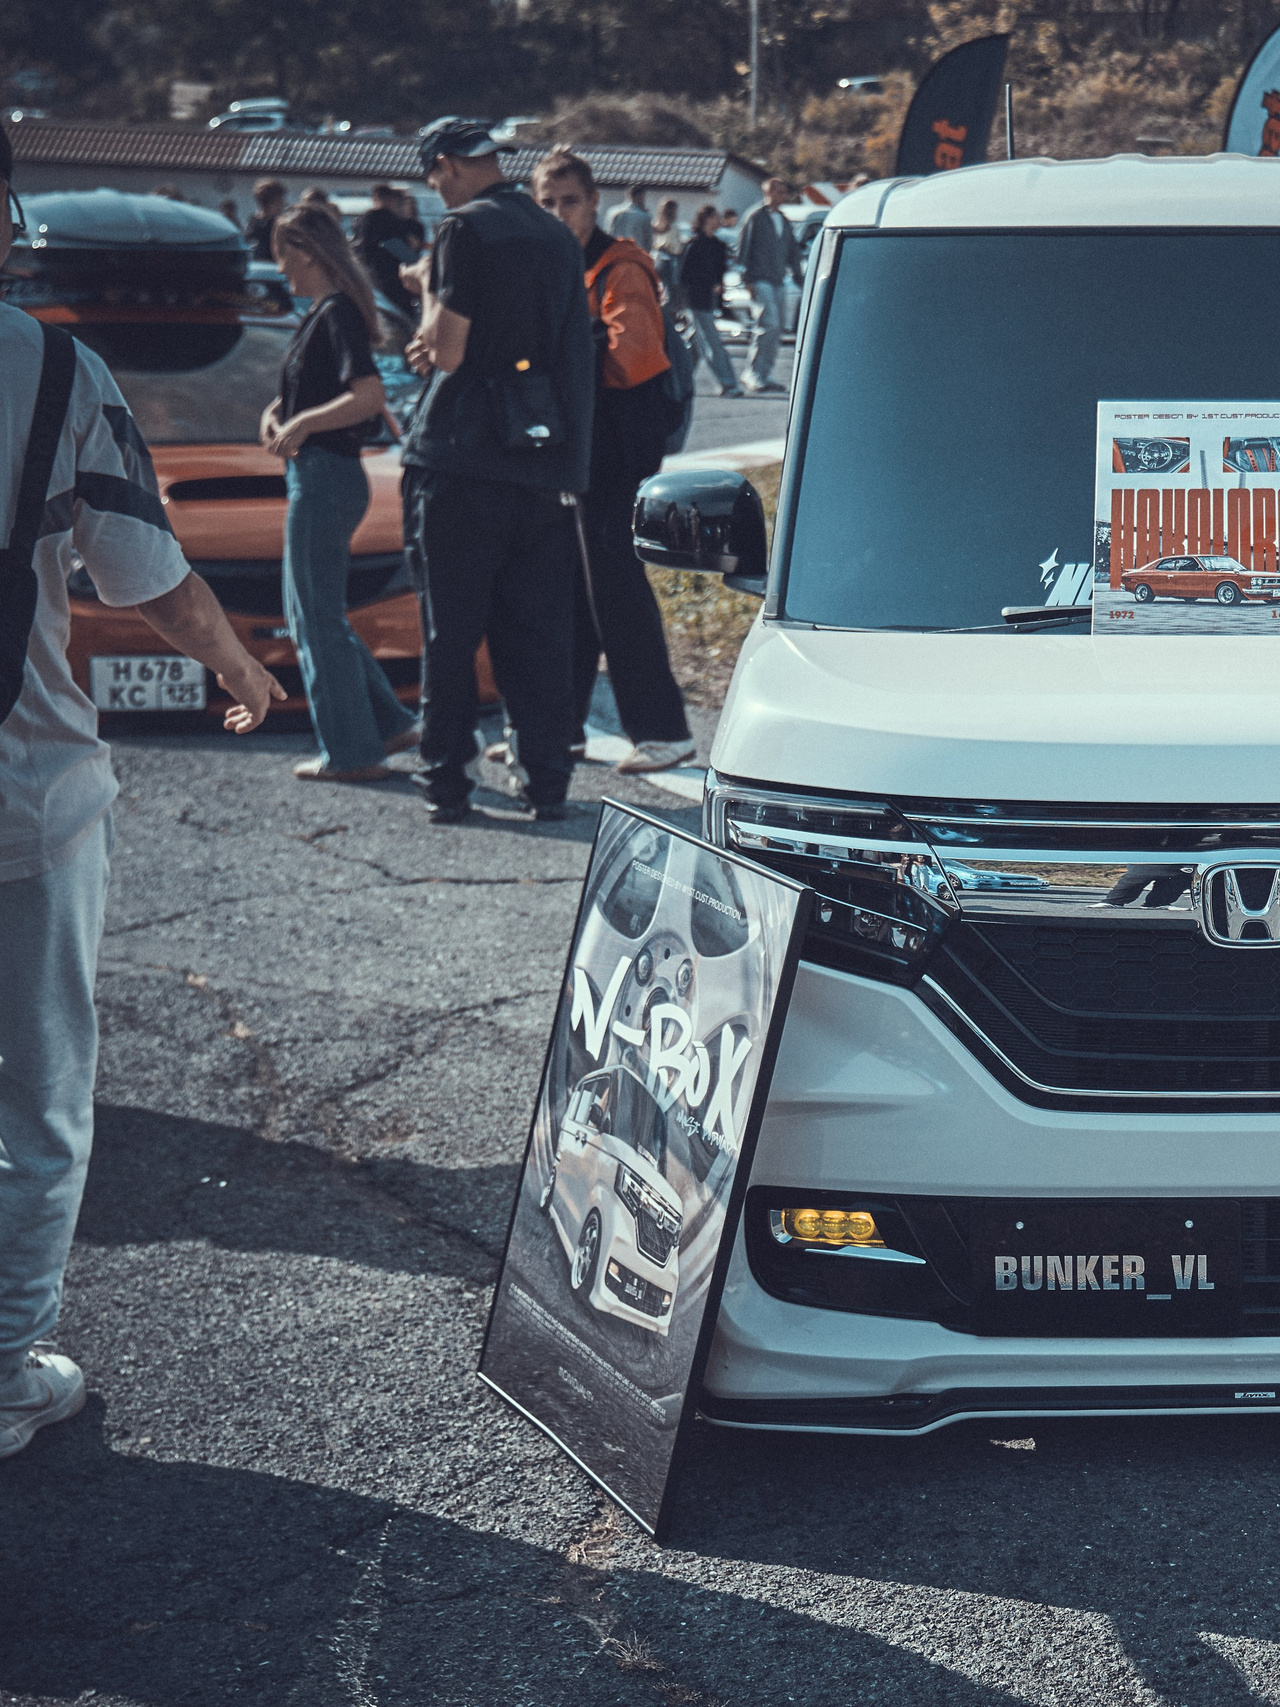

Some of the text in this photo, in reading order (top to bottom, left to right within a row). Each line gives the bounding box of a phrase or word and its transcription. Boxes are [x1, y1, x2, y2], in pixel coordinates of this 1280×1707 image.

[1109, 610, 1135, 619] 1972
[1272, 610, 1278, 619] 1
[632, 860, 650, 874] POSTER
[994, 1254, 1215, 1300] BUNKER_VL
